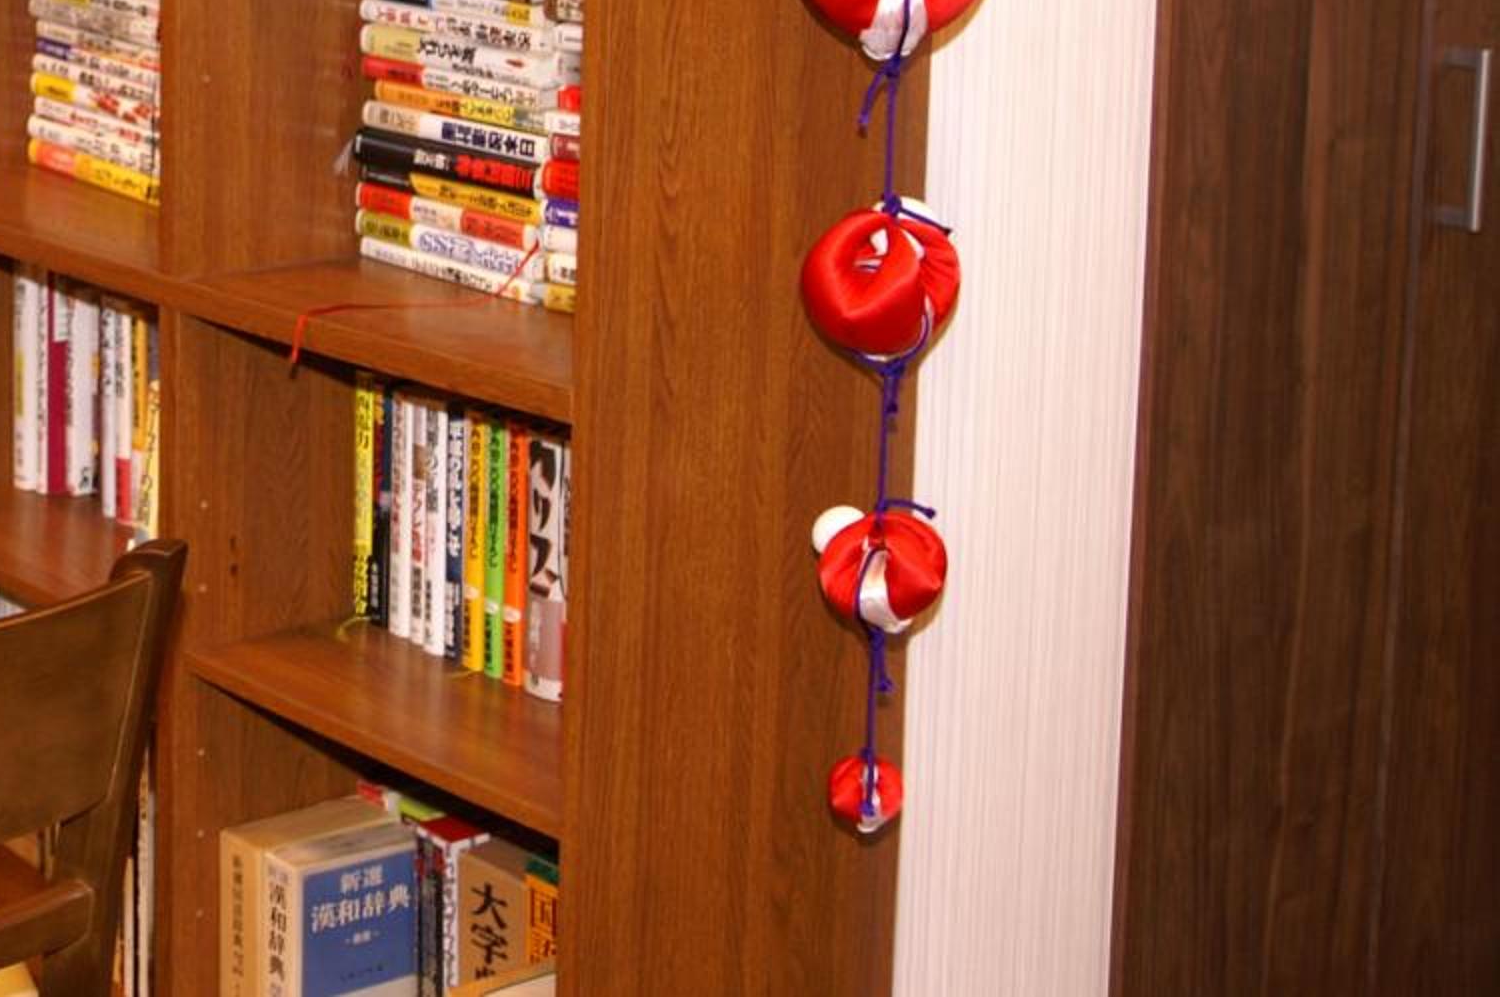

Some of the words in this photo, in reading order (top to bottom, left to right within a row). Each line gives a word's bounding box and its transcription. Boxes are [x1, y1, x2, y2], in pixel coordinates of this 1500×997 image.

[441, 122, 536, 157] 日本改造計画
[268, 884, 288, 982] 漢和辞典
[311, 884, 410, 933] 漢和辞典
